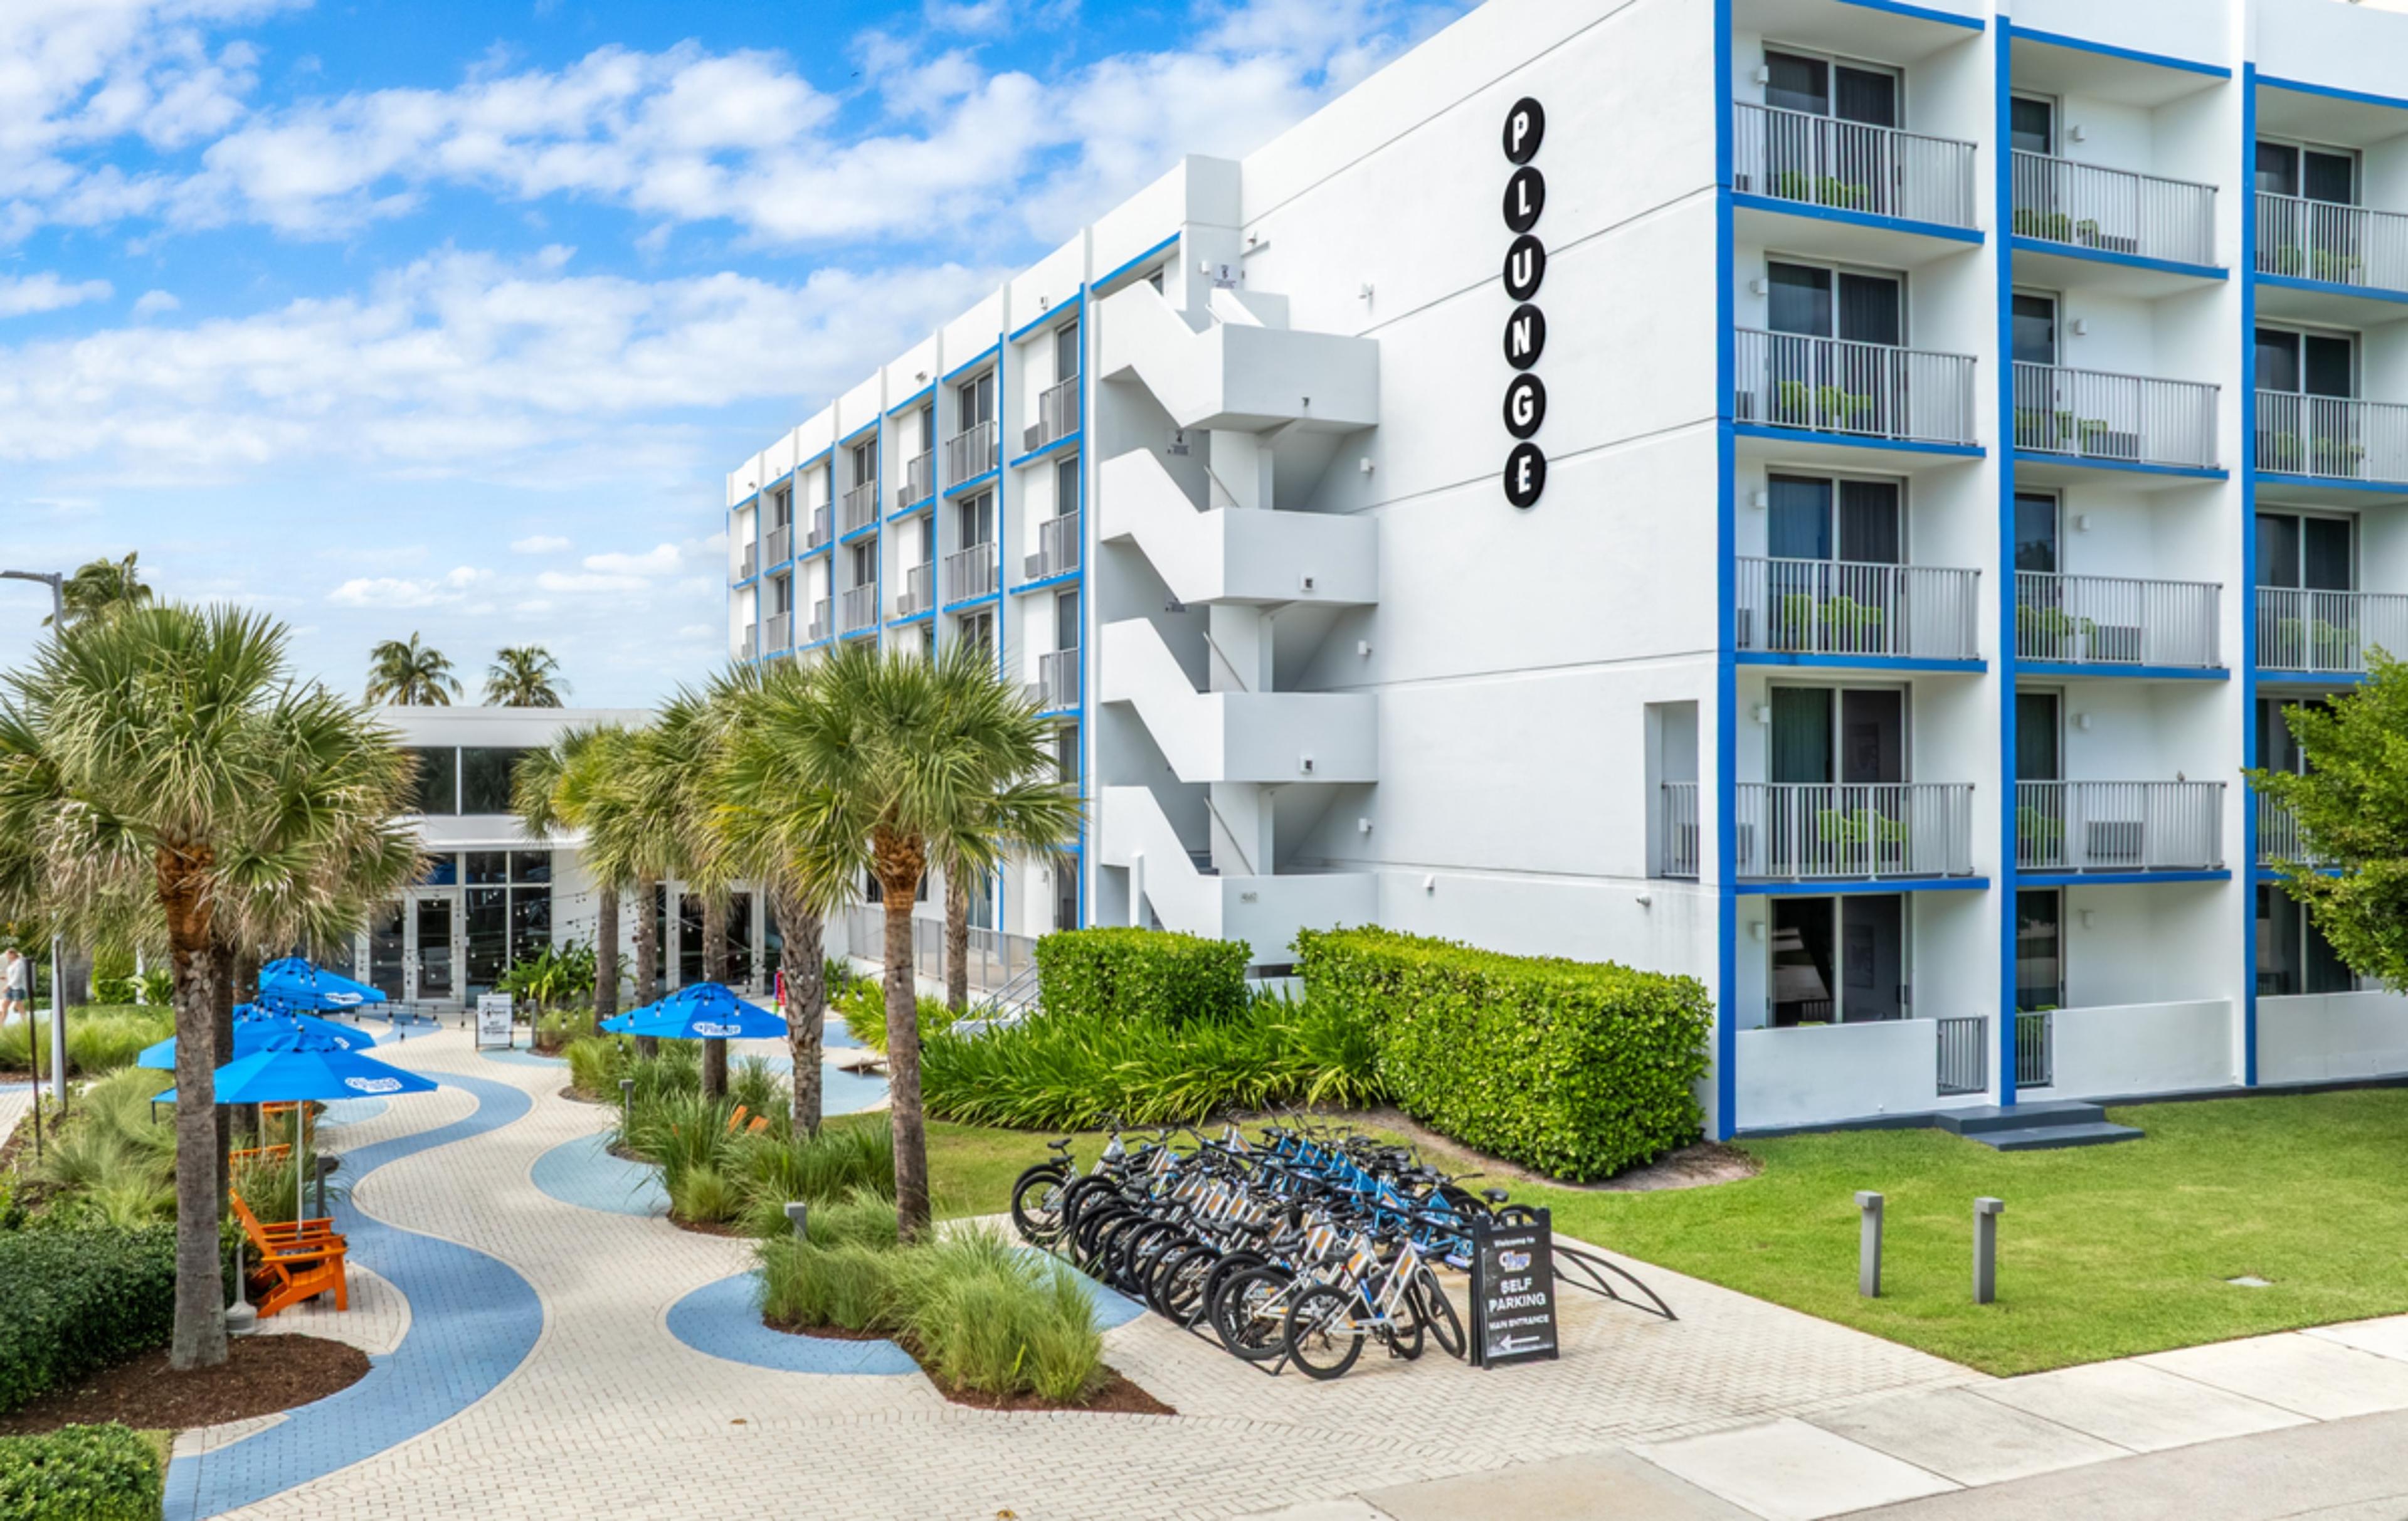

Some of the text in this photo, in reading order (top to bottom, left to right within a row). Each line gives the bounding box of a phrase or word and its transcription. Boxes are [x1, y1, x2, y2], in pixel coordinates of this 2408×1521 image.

[1512, 111, 1533, 494] PLUNGE
[1494, 1238, 1526, 1248] Welcome
[1501, 1277, 1532, 1294] SELF
[1489, 1292, 1546, 1312] PARKING
[1489, 1315, 1550, 1330] MAIN ENTRANCE
